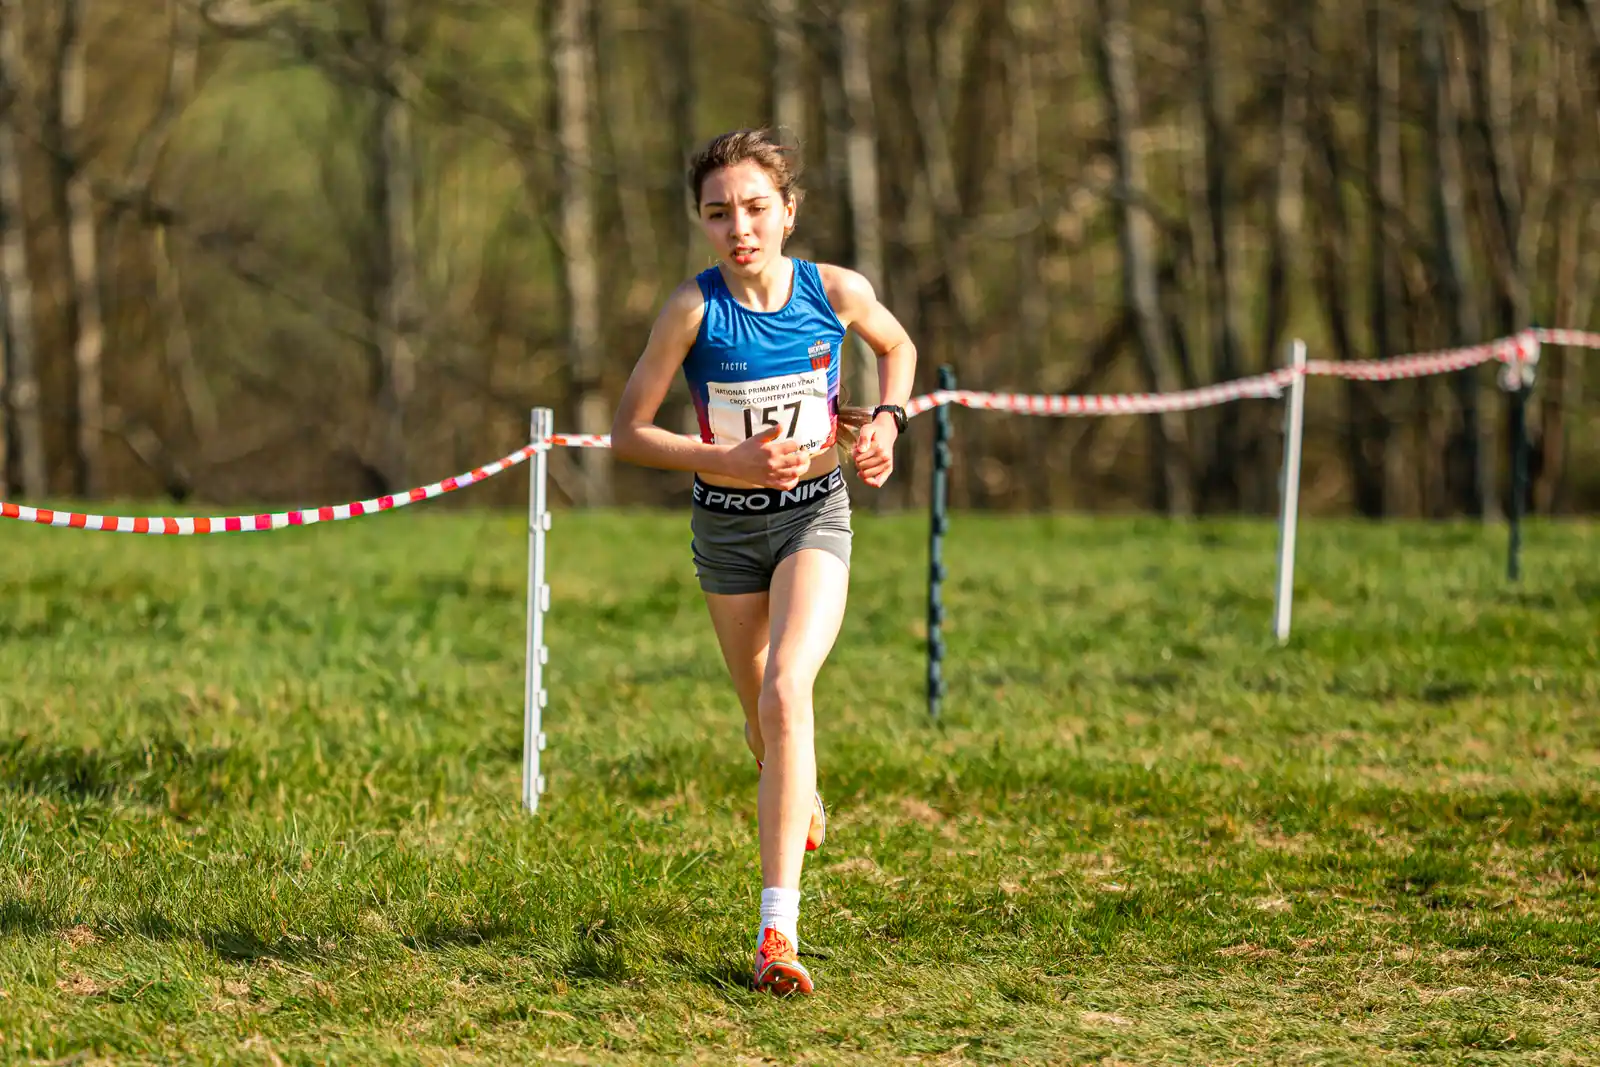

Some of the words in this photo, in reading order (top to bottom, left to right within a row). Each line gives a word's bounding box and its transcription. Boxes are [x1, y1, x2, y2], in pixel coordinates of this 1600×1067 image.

[720, 362, 748, 371] TACTIC
[714, 387, 747, 396] NATIONAL
[748, 384, 780, 395] PRIMARY
[781, 382, 797, 391] AND
[797, 379, 815, 388] YEAR
[752, 393, 786, 404] COUNTRY
[743, 400, 802, 440] 157
[705, 491, 770, 511] PRO
[779, 467, 841, 507] NIKE
